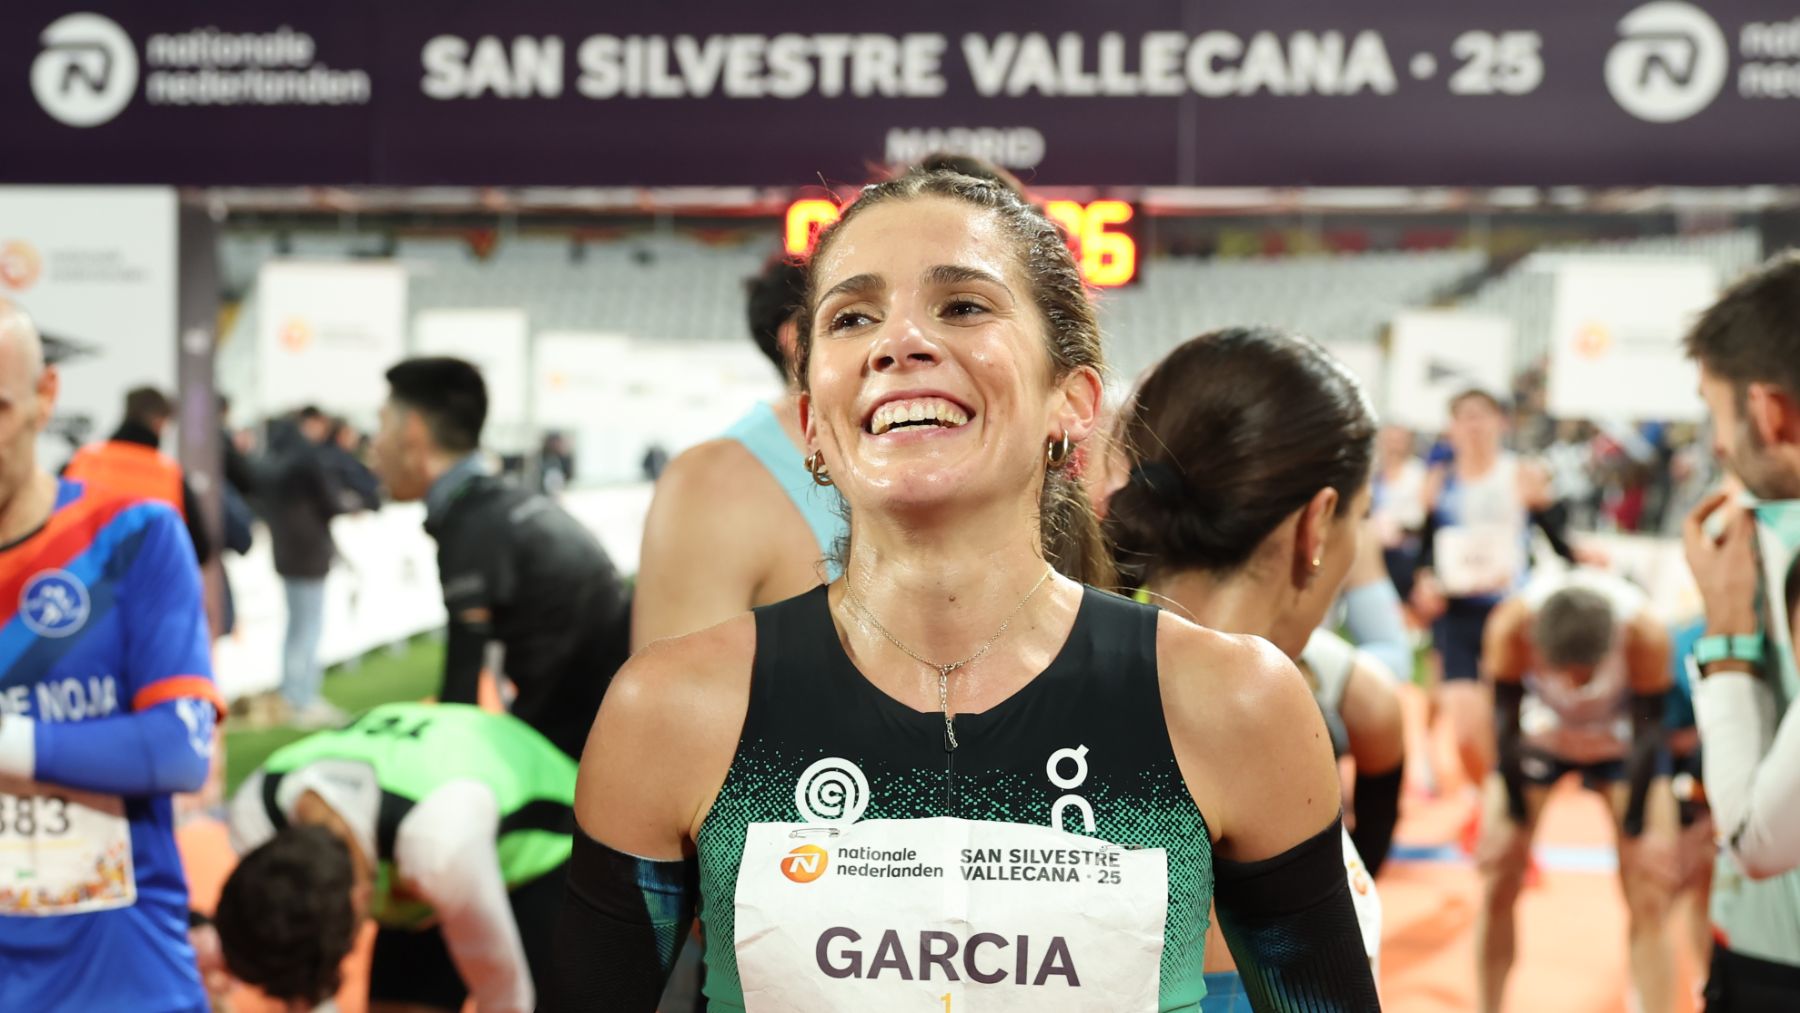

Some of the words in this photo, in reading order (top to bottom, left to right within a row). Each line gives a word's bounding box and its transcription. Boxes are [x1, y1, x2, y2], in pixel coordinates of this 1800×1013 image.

[146, 26, 315, 66] nationale
[423, 36, 563, 98] SAN
[578, 34, 946, 98] SILVESTRE
[963, 31, 1397, 97] VALLECANA
[1450, 31, 1543, 94] 25
[146, 65, 371, 105] nederlanden
[0, 795, 70, 836] 83
[837, 846, 917, 861] nationale
[960, 848, 1001, 863] SAN
[1009, 849, 1121, 867] SILVESTRE
[836, 863, 944, 878] nederlanden
[960, 866, 1080, 882] VALLECANA
[1098, 870, 1122, 884] 25
[815, 926, 1081, 987] GARCIA
[940, 992, 952, 1013] 1
